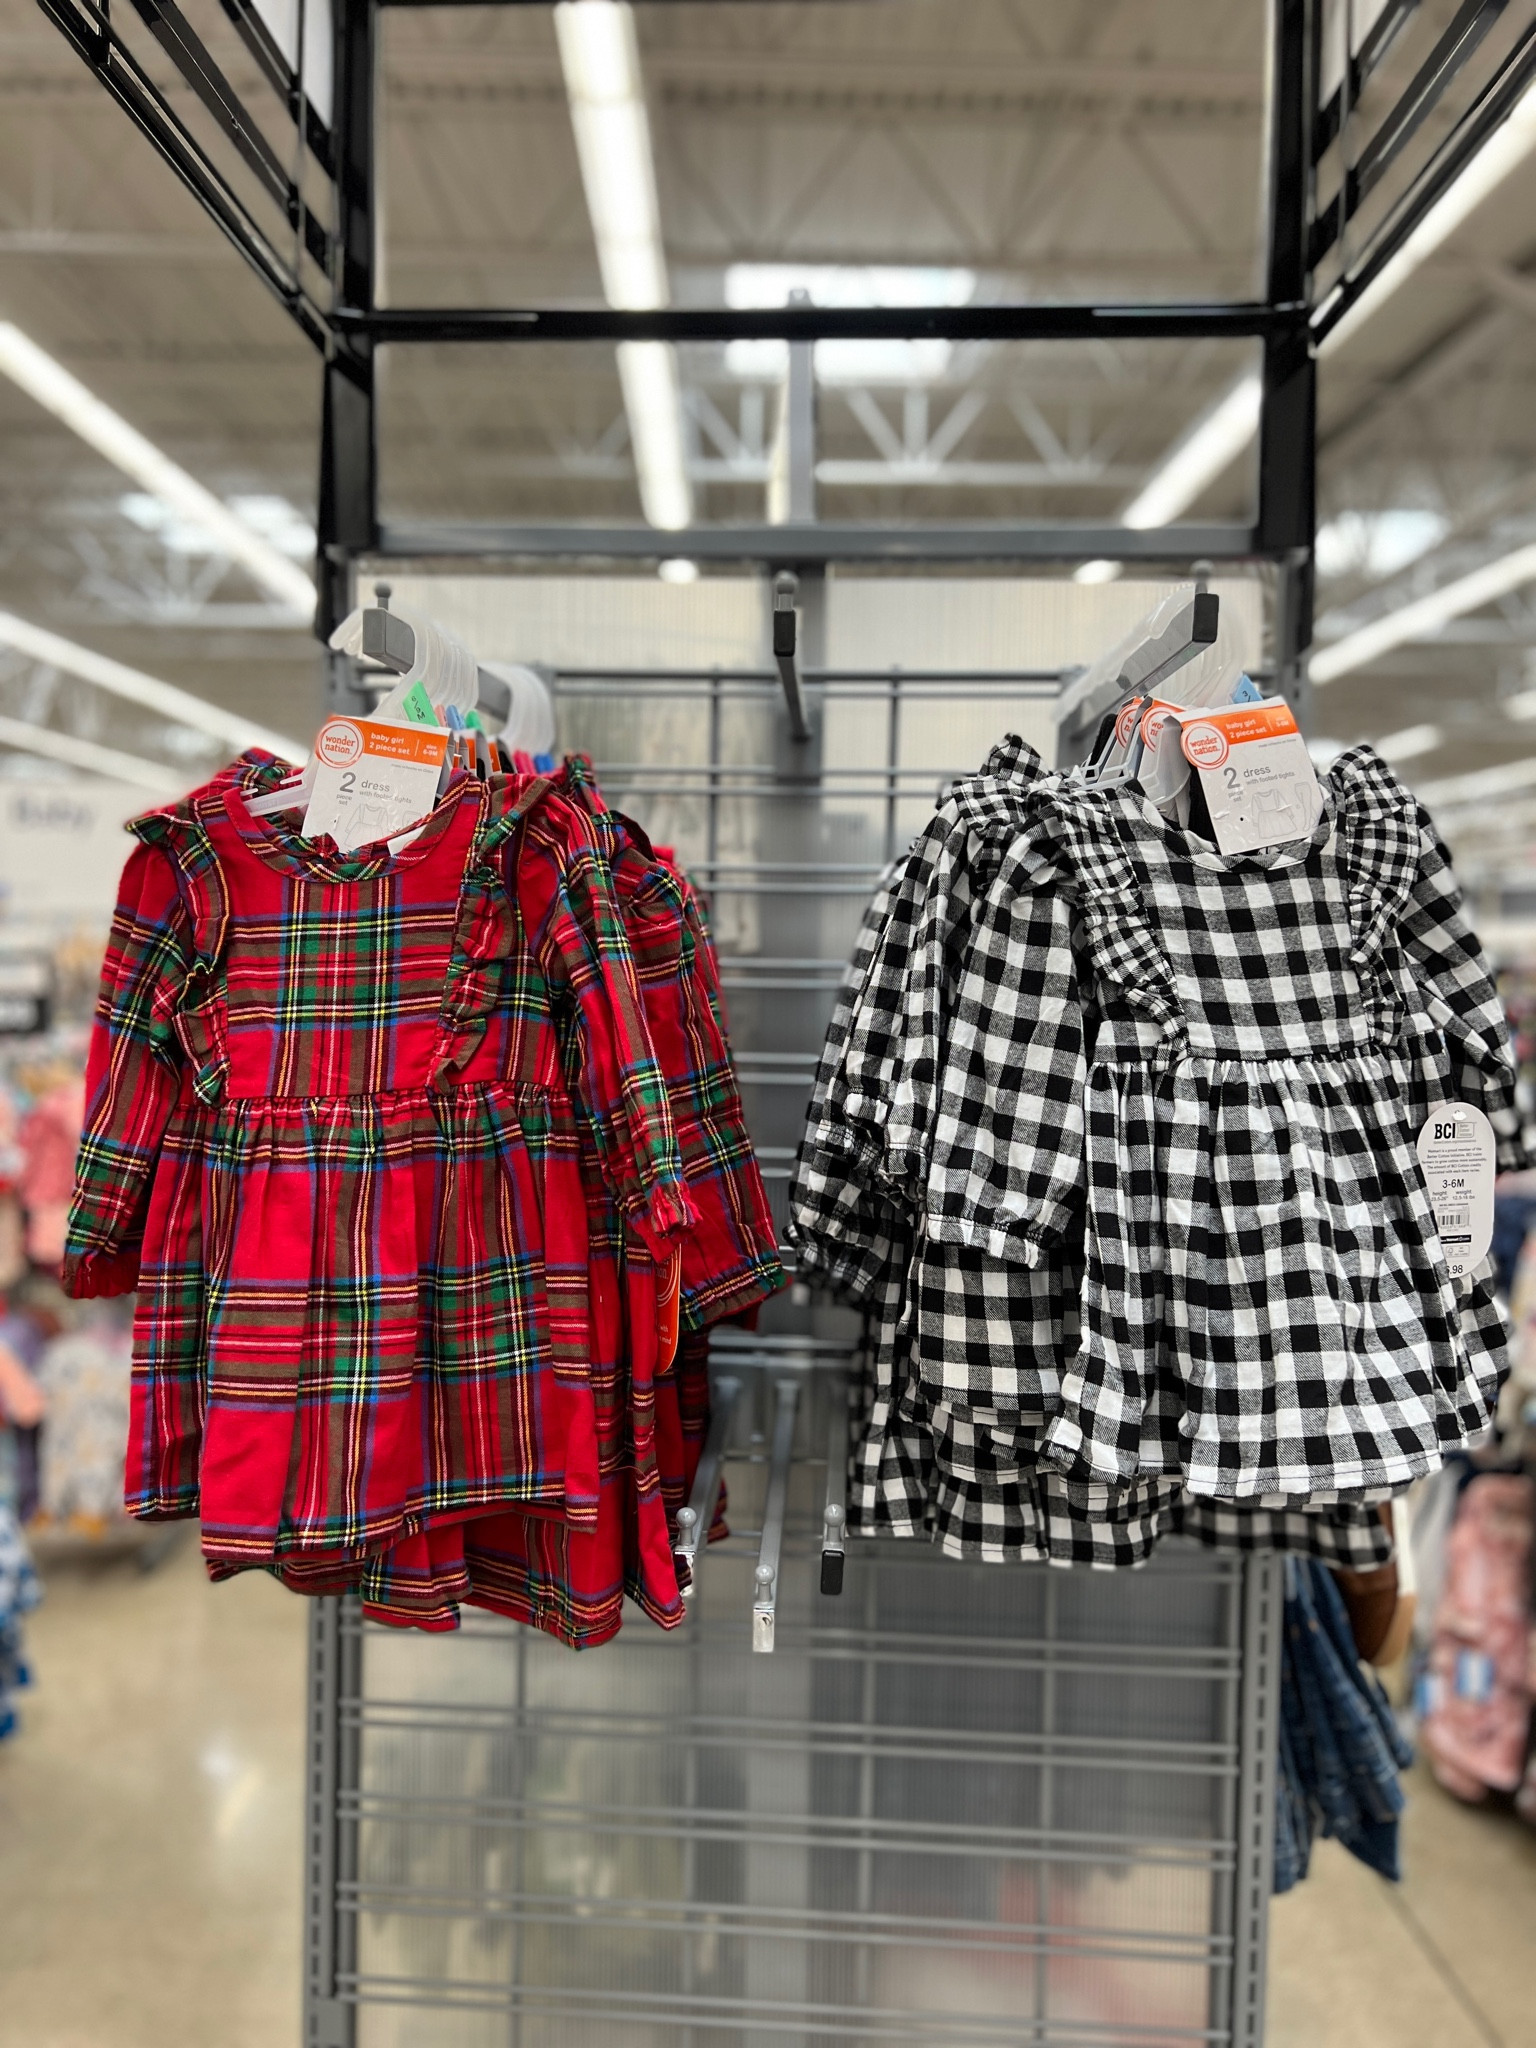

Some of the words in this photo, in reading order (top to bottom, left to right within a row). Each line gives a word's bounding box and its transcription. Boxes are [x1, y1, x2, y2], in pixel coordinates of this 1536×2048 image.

[1225, 721, 1243, 730] baby
[1243, 718, 1257, 728] girl
[370, 732, 390, 743] baby
[390, 736, 405, 745] girl
[1229, 731, 1235, 739] 2
[1235, 729, 1255, 739] piece
[1255, 726, 1268, 734] set
[325, 734, 356, 747] wonder
[1189, 734, 1219, 748] wonder
[369, 741, 375, 749] 2
[375, 742, 397, 753] piece
[397, 746, 411, 755] set
[339, 771, 357, 794] 2
[361, 779, 391, 793] dress
[1223, 767, 1241, 790] 2
[1243, 765, 1271, 778] dress
[1245, 778, 1260, 786] with
[1259, 774, 1279, 784] footed
[1278, 771, 1296, 781] tights
[335, 793, 353, 801] piece
[1434, 1122, 1456, 1140] BCI
[1442, 1178, 1465, 1189] 3-6M
